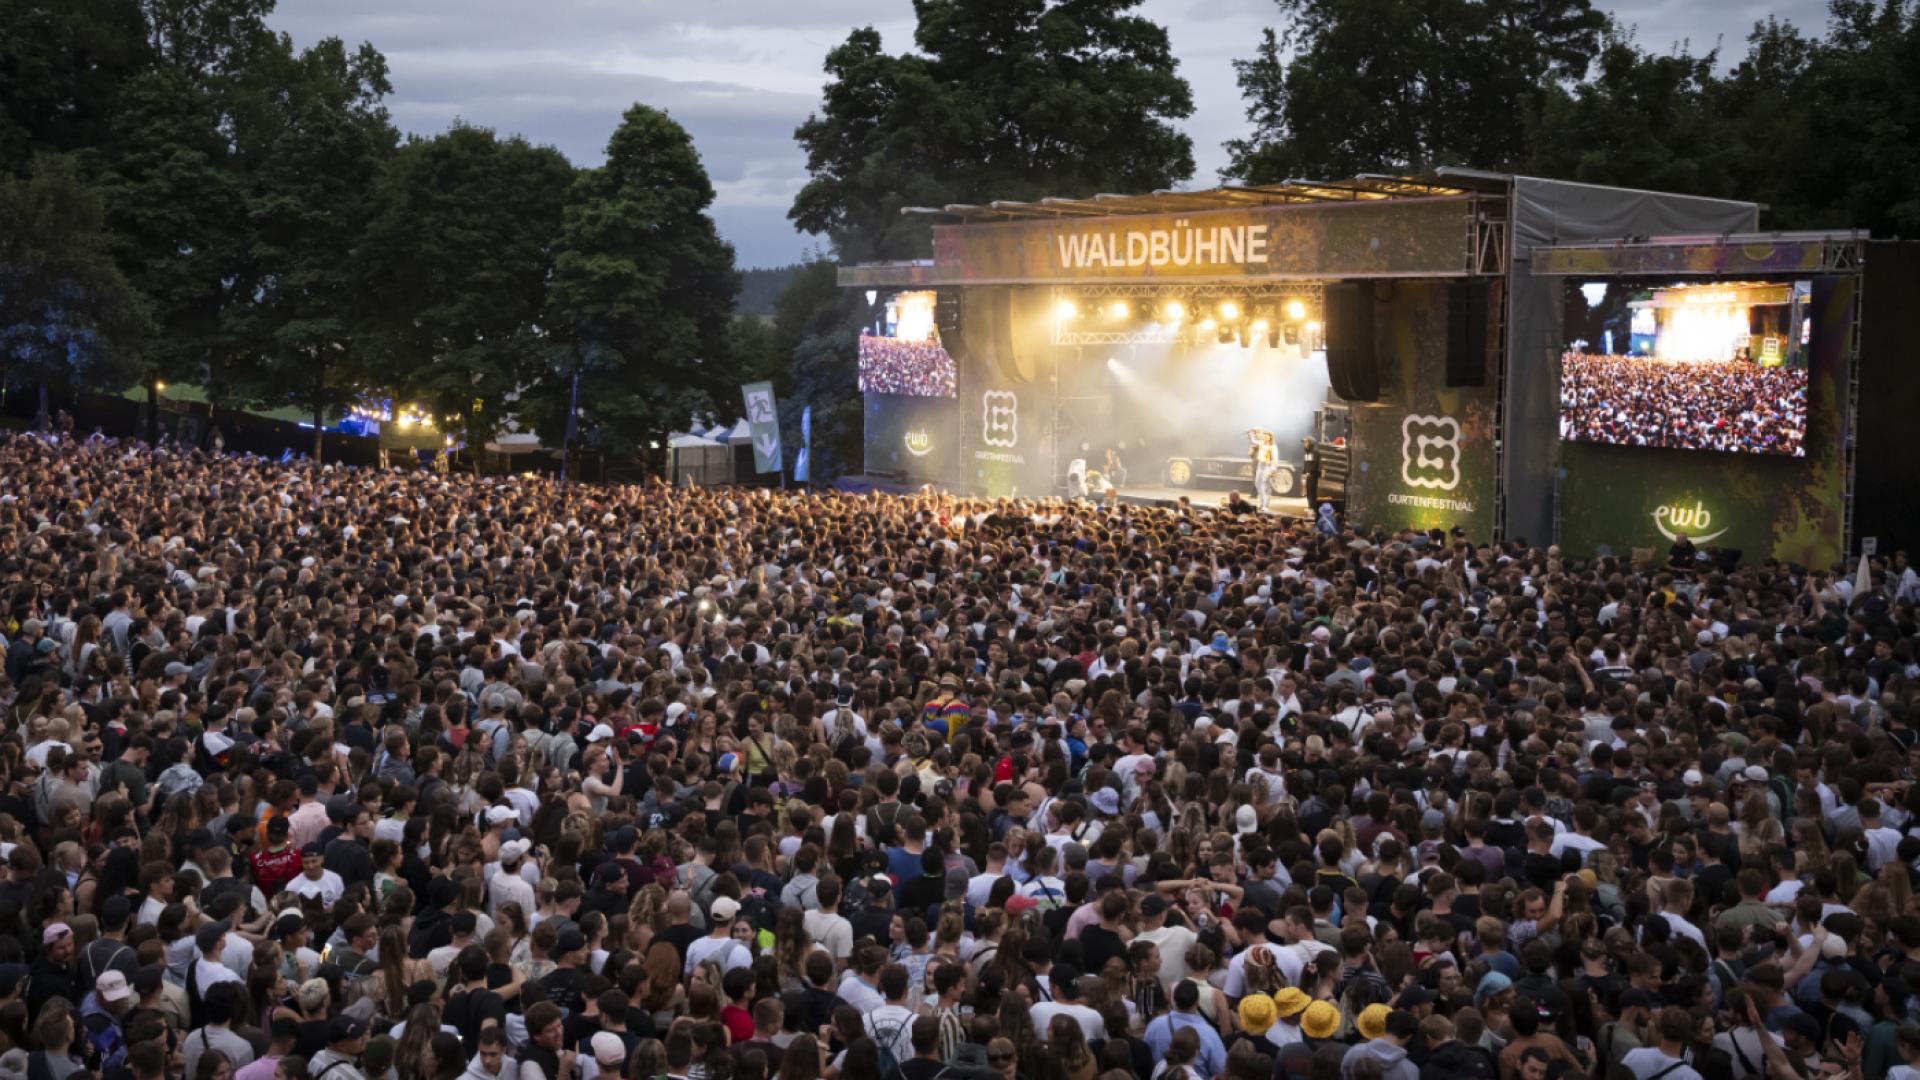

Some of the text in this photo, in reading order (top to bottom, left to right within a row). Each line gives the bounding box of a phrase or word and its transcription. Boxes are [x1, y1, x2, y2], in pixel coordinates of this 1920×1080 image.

[1058, 219, 1268, 268] WALDBÜHNE
[1388, 493, 1474, 512] GURTENFESTIVAL
[1650, 500, 1711, 534] ewb
